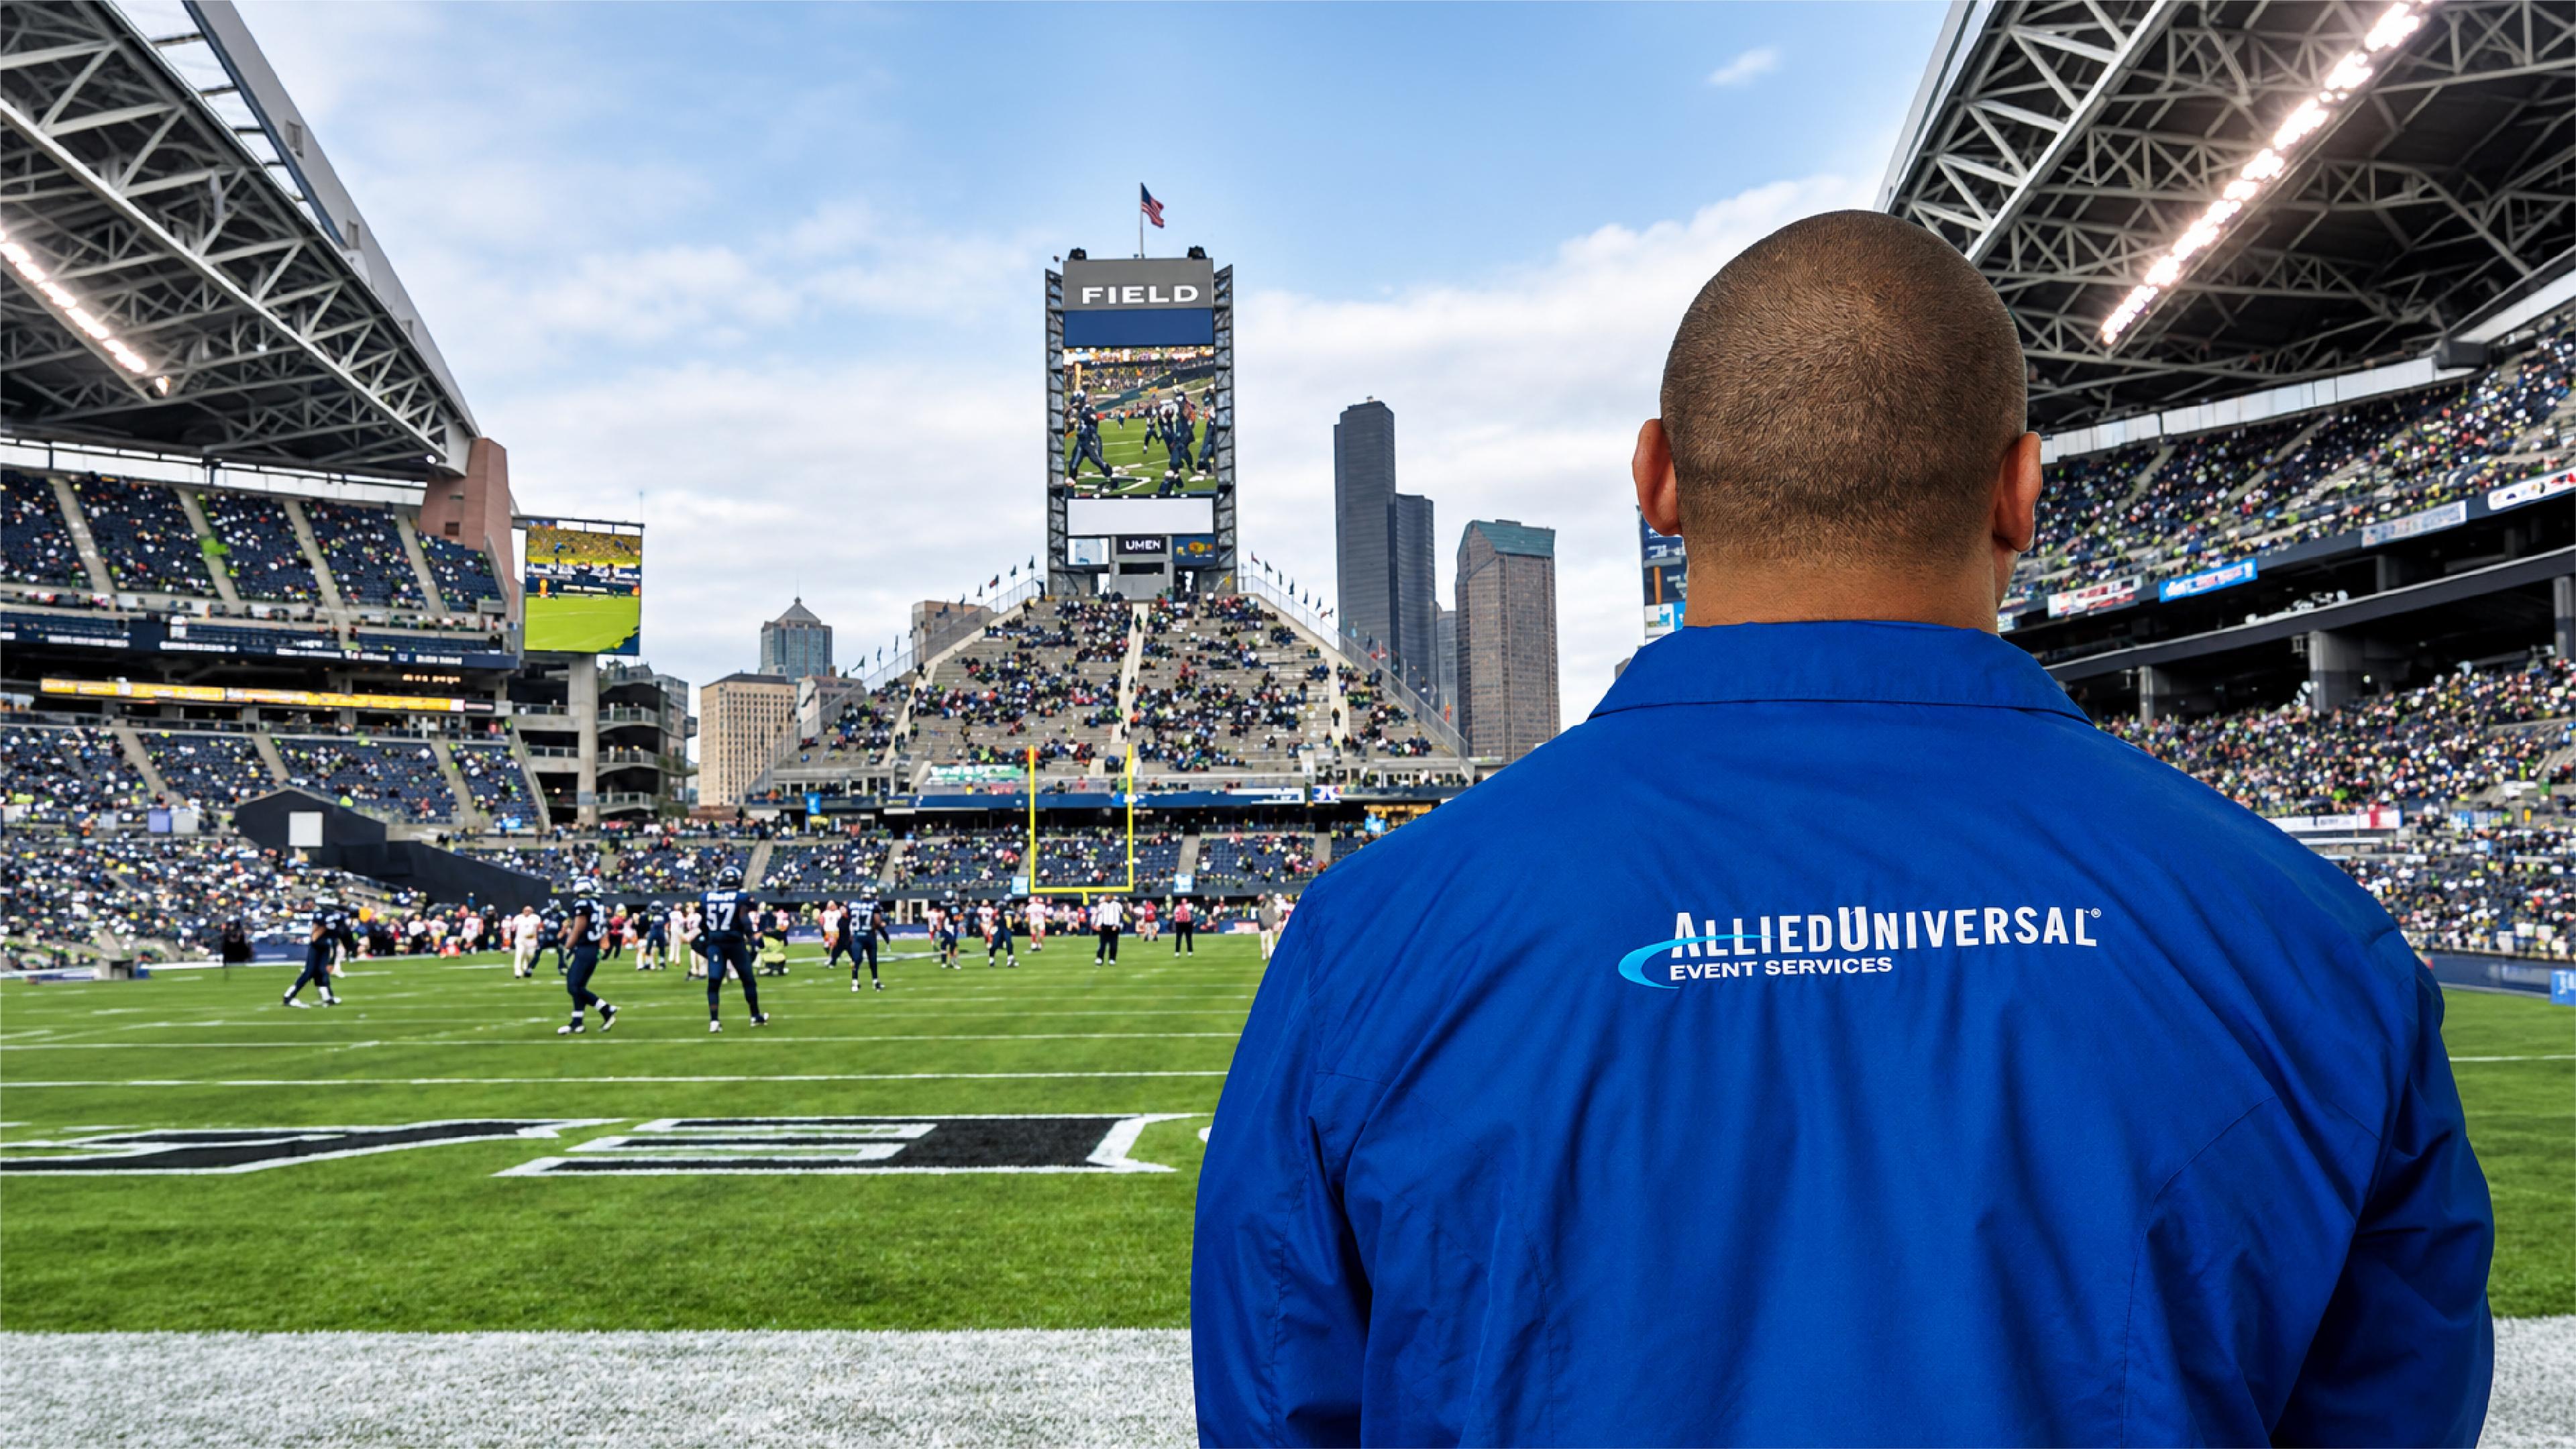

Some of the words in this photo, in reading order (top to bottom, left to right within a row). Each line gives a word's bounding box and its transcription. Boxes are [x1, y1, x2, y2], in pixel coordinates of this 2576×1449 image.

[1082, 285, 1199, 304] FIELD
[1126, 539, 1161, 551] UMEN
[706, 902, 736, 932] 57
[1670, 961, 1758, 981] EVENT
[1765, 957, 1893, 975] SERVICES
